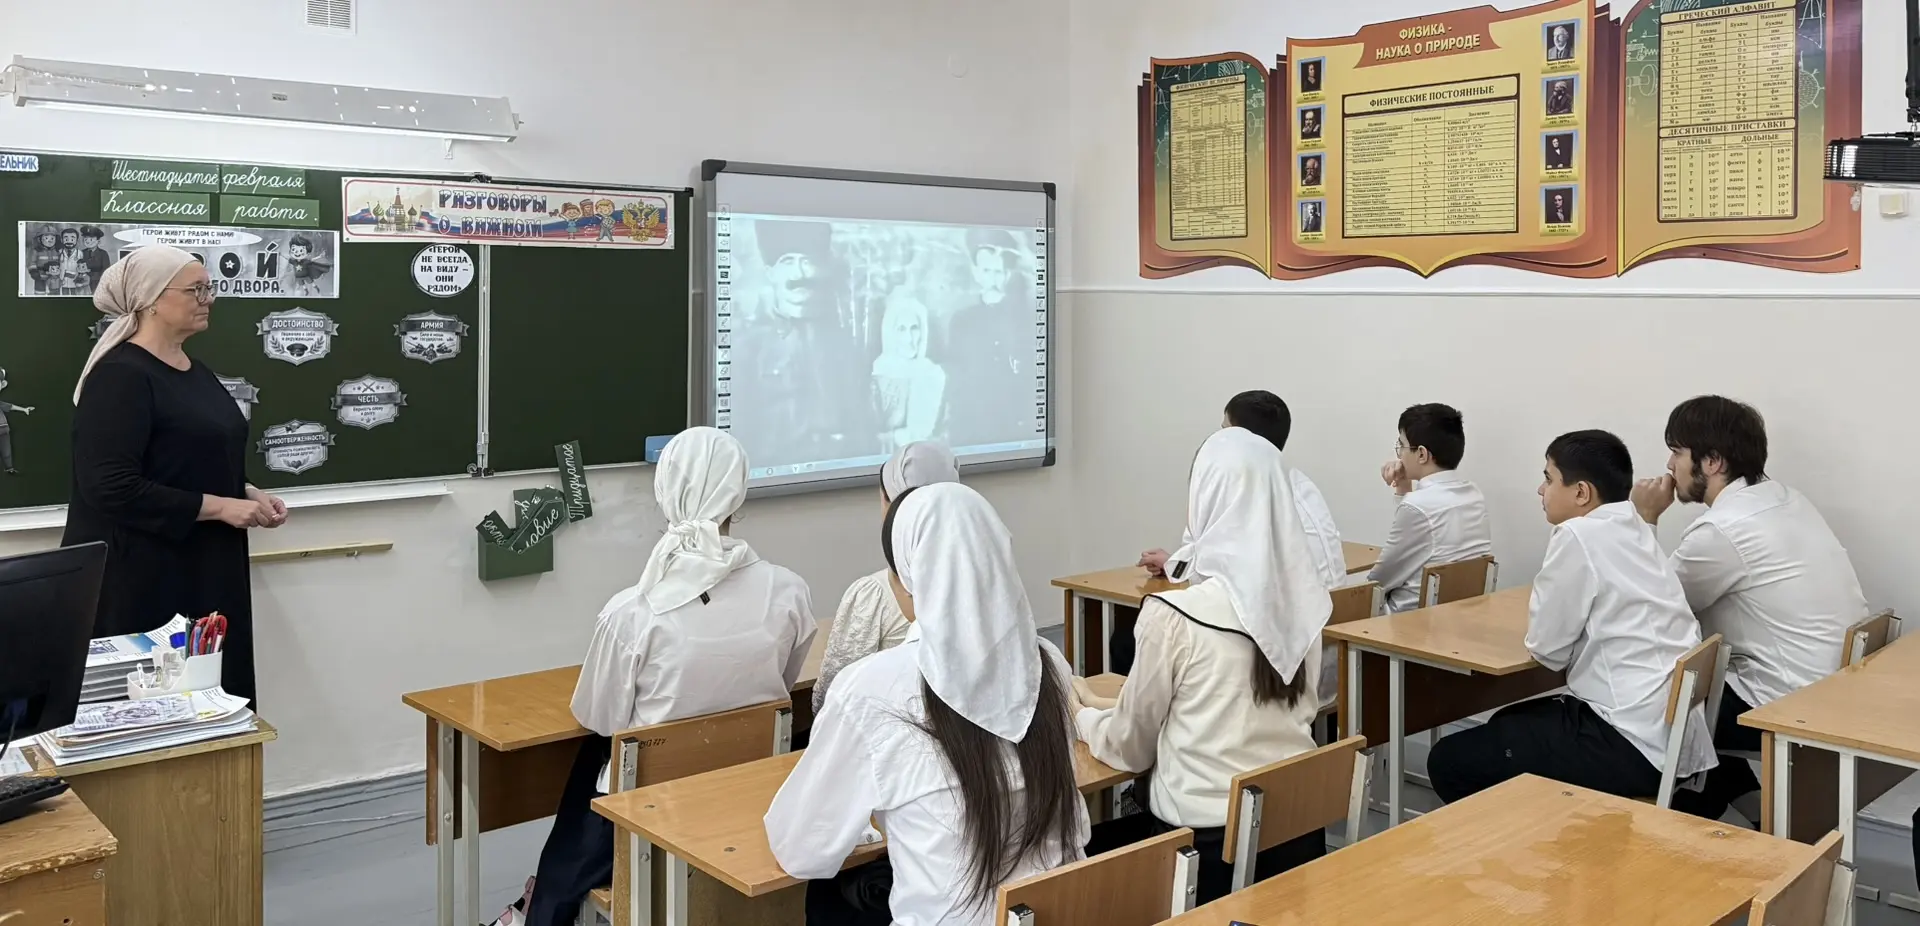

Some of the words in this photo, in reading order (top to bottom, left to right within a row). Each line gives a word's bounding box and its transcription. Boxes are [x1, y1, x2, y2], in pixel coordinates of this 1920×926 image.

[1678, 7, 1730, 20] ГРЕЧЕСКИЙ
[1732, 1, 1777, 13] АЛФАВИТ
[1399, 22, 1446, 40] ФИЗИКА
[1376, 44, 1412, 60] НАУКА
[1414, 42, 1422, 55] О
[1425, 34, 1480, 53] ПРИРОДЕ
[1369, 92, 1428, 107] ФИЗИЧЕСКИЕ
[1429, 85, 1495, 101] ПОСТОЯННЫЕ
[1668, 124, 1729, 136] ДЕСЯТИЧНЫЕ
[1731, 120, 1786, 131] ПРИСТАВКИ
[1677, 138, 1712, 146] КРАТНЫЕ
[1741, 134, 1779, 143] ДОЛЬНЫЕ
[112, 160, 219, 190] Шестнадцатое
[103, 191, 208, 216] Классная
[438, 189, 547, 213] РАЗГОВОРЫ
[438, 215, 451, 234] О
[460, 216, 543, 238] ВАЖНОМ
[233, 280, 284, 294] ДВОРА.
[272, 320, 324, 328] ДОСТОИНСТВО
[420, 321, 444, 329] АРМИЯ
[358, 395, 379, 403] ЧЕСТЬ
[265, 434, 325, 445] САМООТВЕРЖЕННОСТЬ
